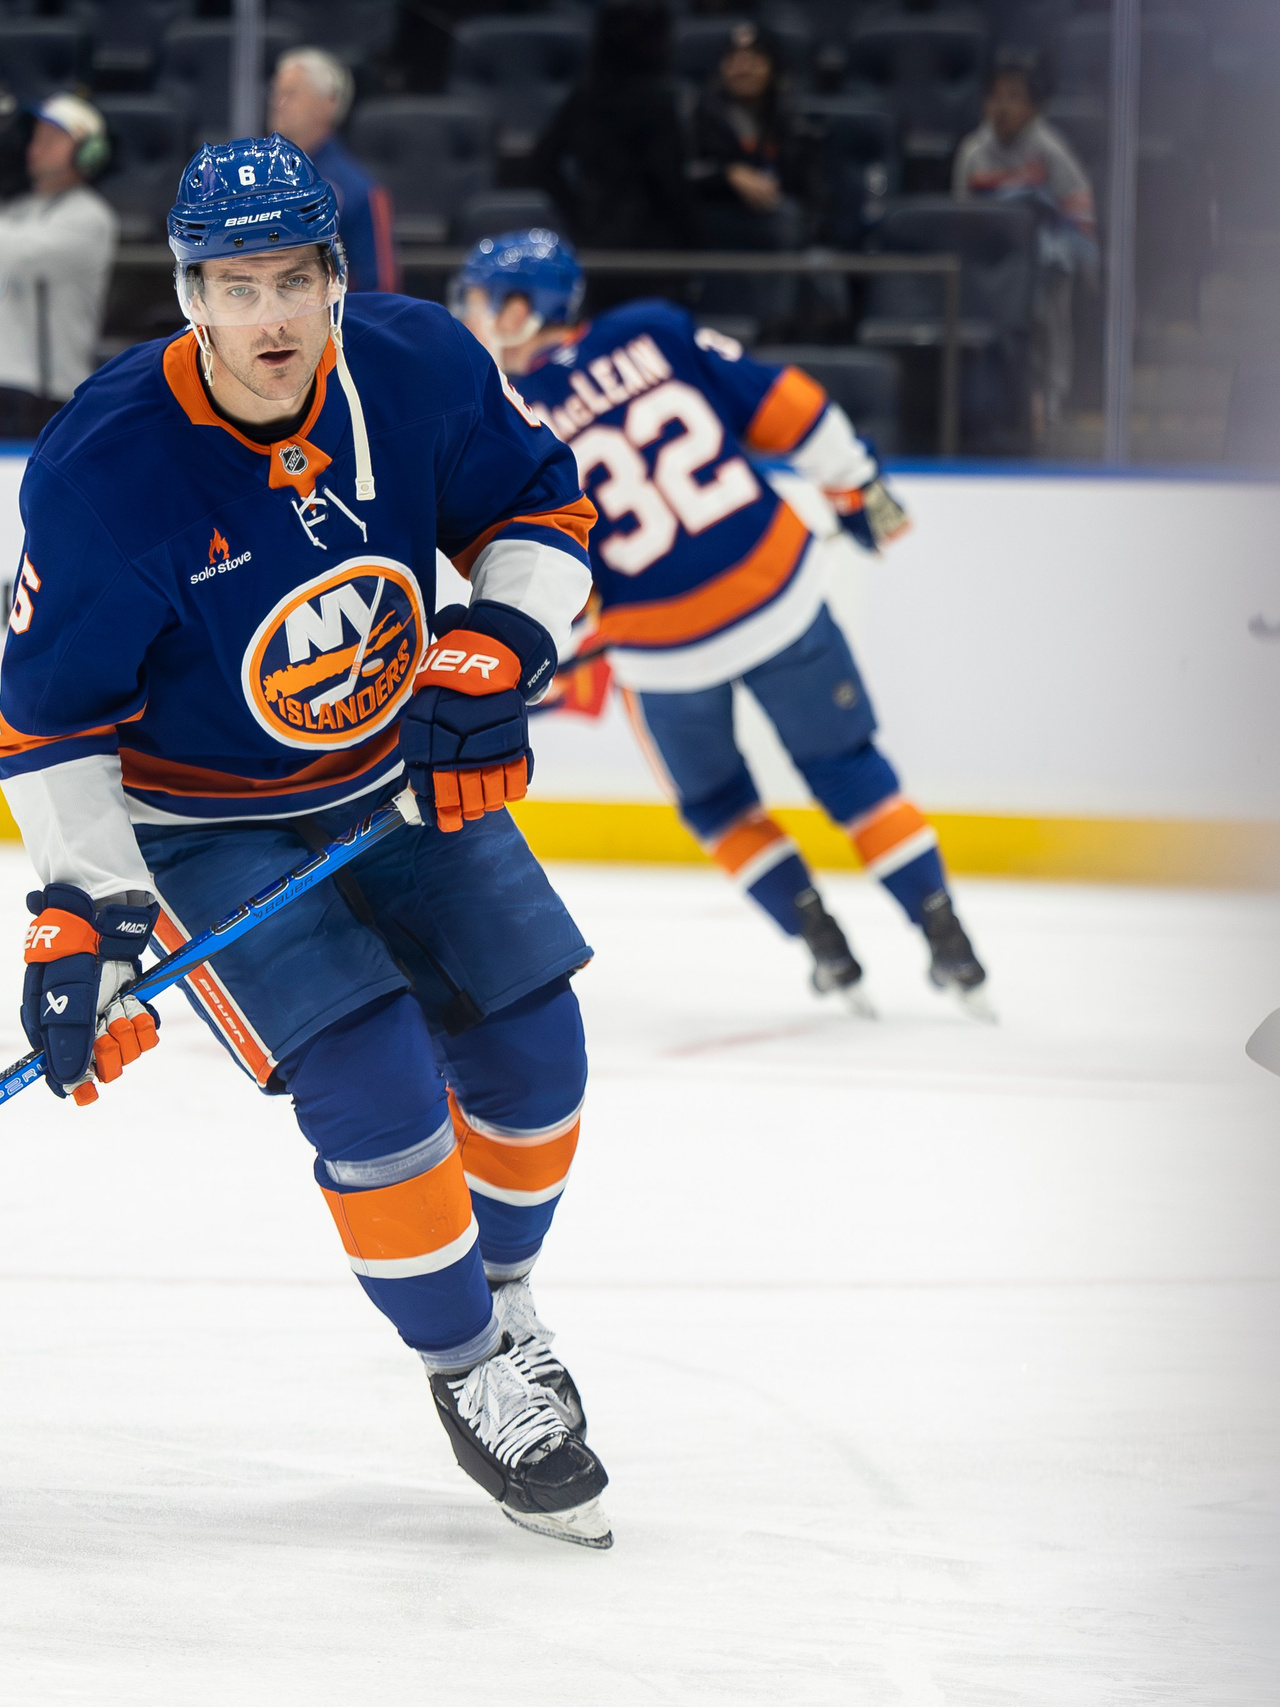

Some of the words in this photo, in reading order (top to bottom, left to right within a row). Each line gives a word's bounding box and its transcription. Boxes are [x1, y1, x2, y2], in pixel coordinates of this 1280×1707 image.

[238, 165, 256, 186] 6
[225, 211, 282, 227] BAUER
[568, 378, 762, 578] 32
[190, 566, 216, 584] solo
[217, 551, 252, 574] stove
[285, 576, 386, 668] NY
[277, 638, 411, 731] ISLANDERS
[265, 874, 314, 915] BAUER
[116, 920, 149, 935] MACH
[198, 977, 246, 1045] BAUER
